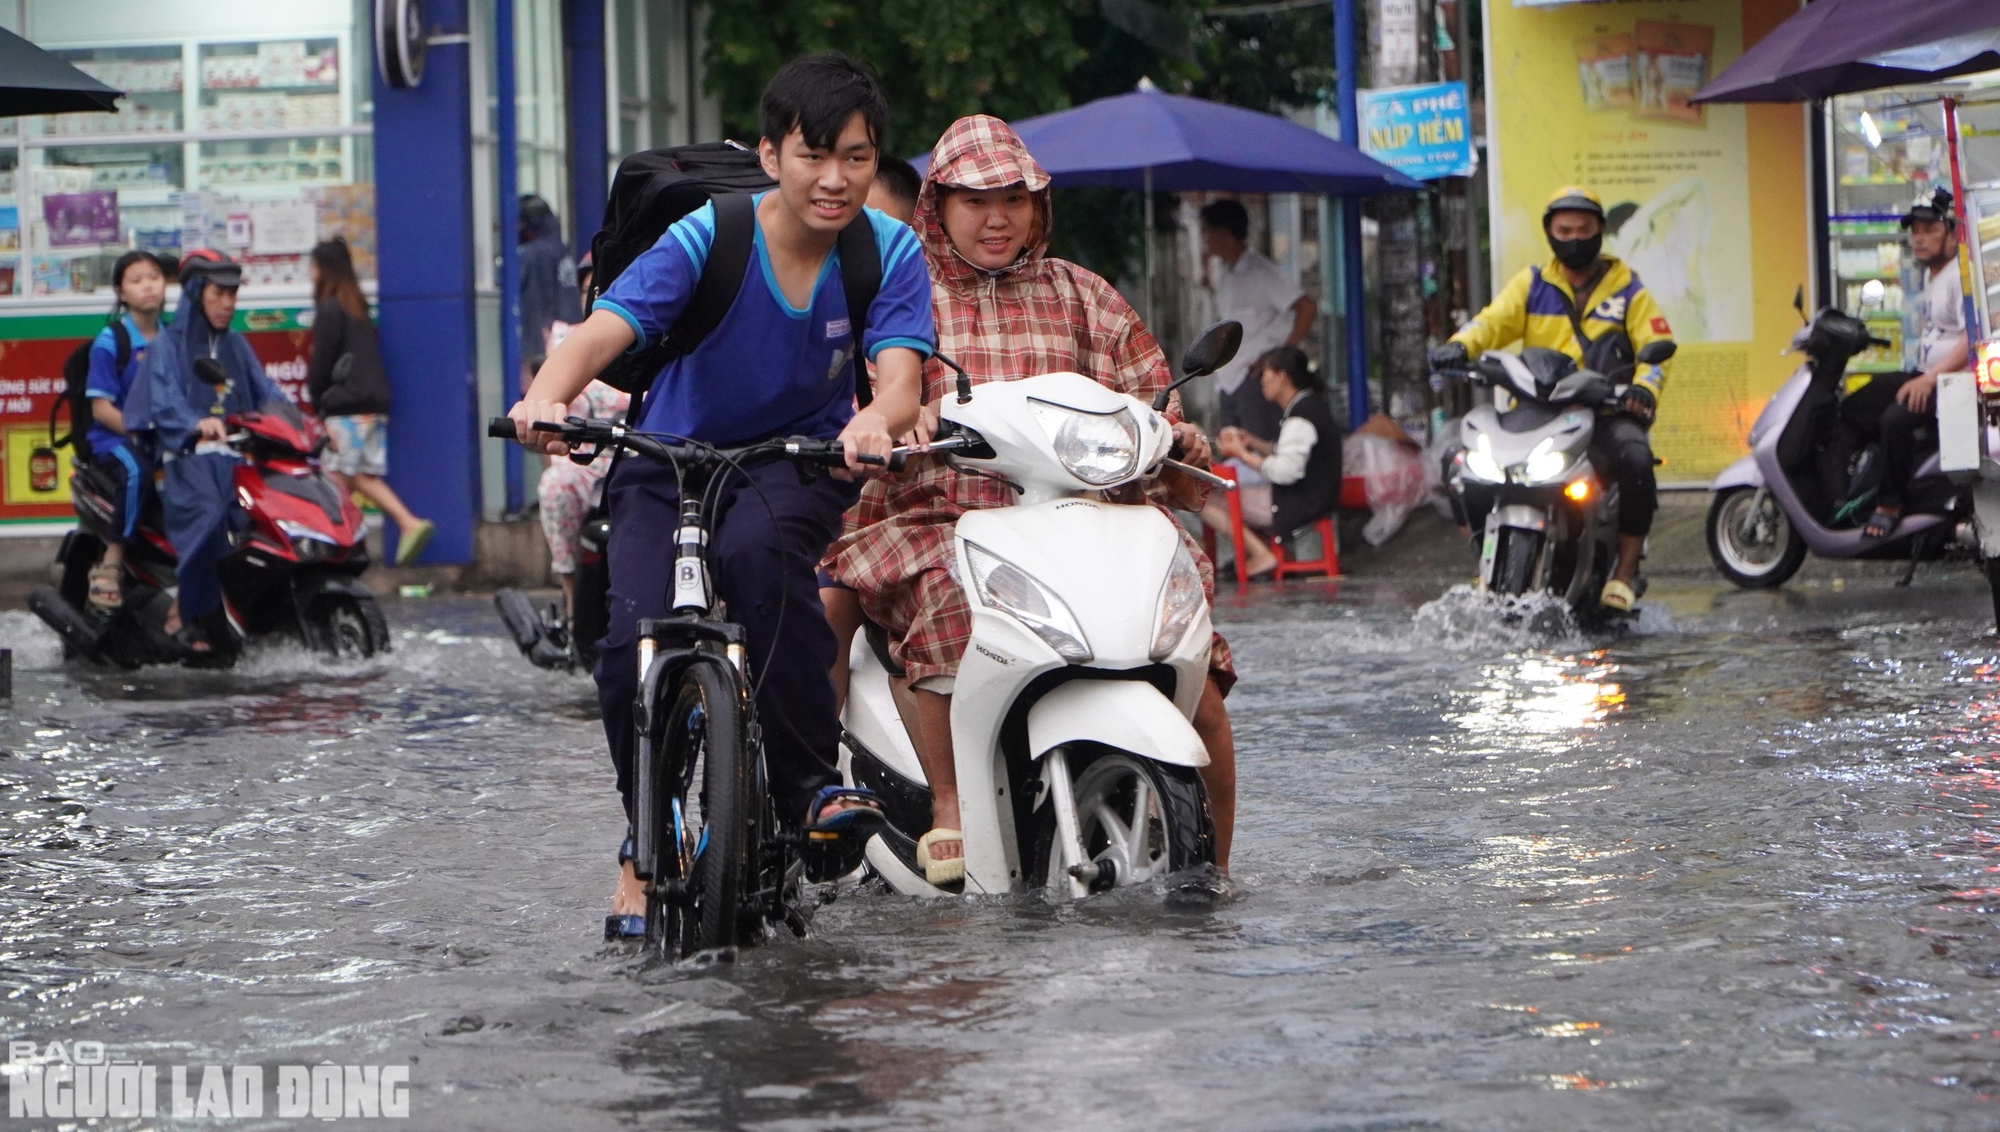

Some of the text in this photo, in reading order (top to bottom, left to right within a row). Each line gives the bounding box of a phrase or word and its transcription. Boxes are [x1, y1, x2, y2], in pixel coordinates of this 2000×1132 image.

[1411, 90, 1462, 114] PHÊ
[1417, 111, 1463, 146] HẺM
[1055, 500, 1100, 510] HONDA
[681, 566, 694, 581] B
[975, 643, 1010, 666] HONDA
